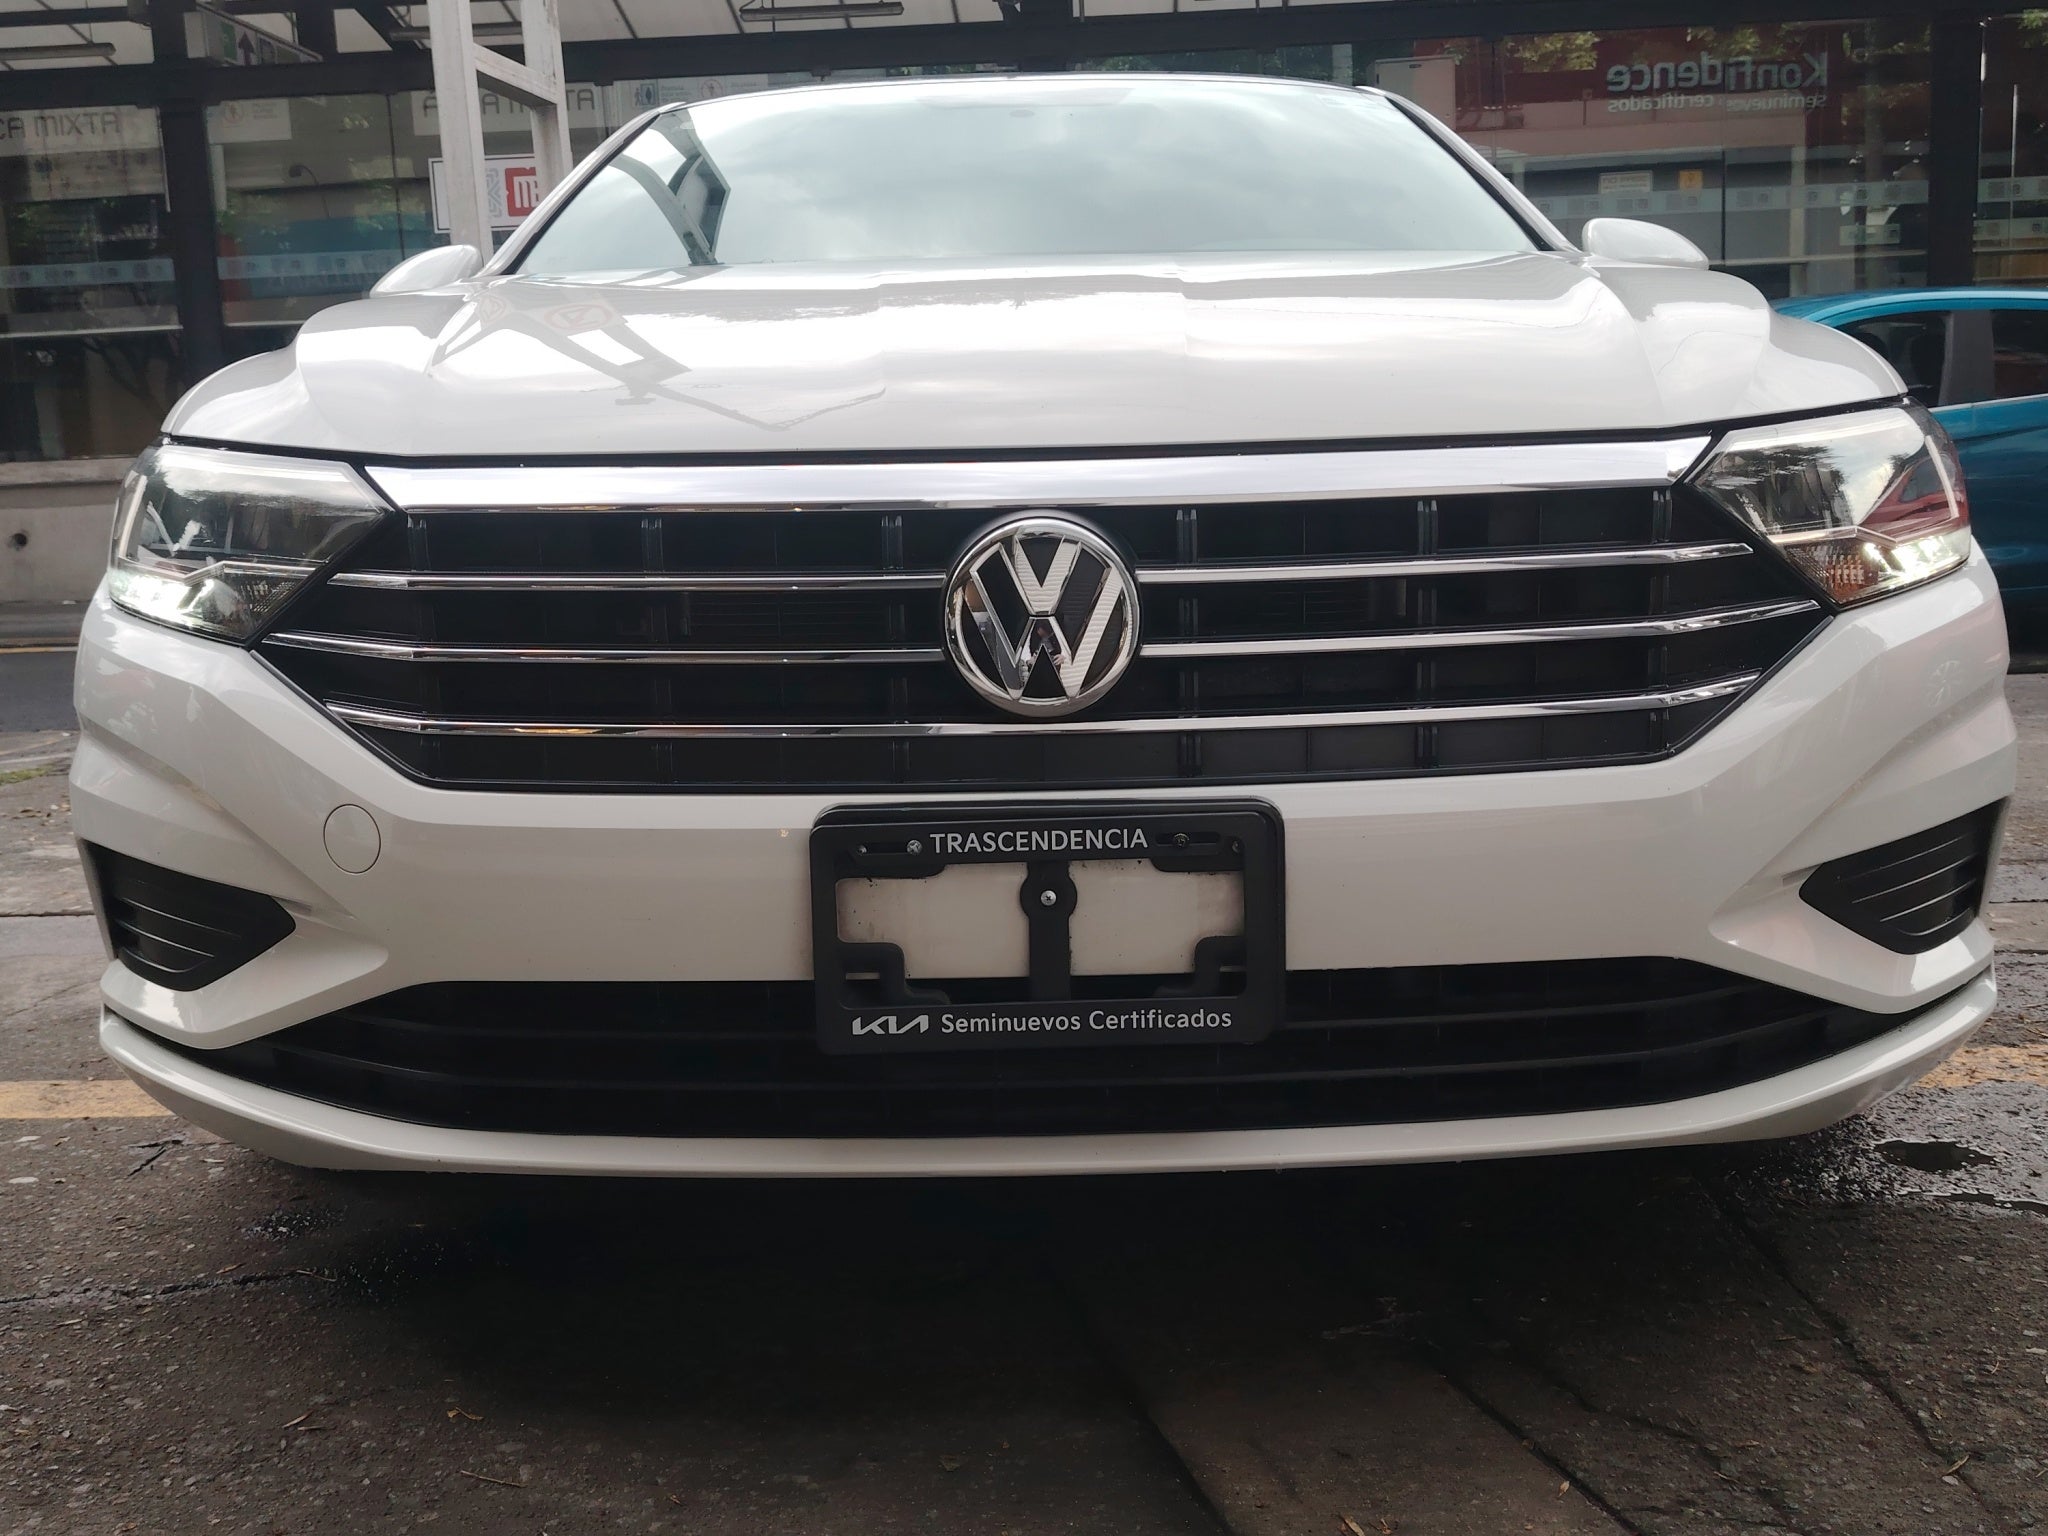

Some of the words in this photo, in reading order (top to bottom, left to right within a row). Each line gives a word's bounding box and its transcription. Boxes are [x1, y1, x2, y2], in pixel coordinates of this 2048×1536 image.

[34, 111, 120, 136] MIXTA
[930, 828, 1148, 853] TRASCENDENCIA
[852, 1015, 929, 1035] KIA
[941, 1012, 1081, 1033] Seminuevos
[1089, 1008, 1232, 1030] Certificados
